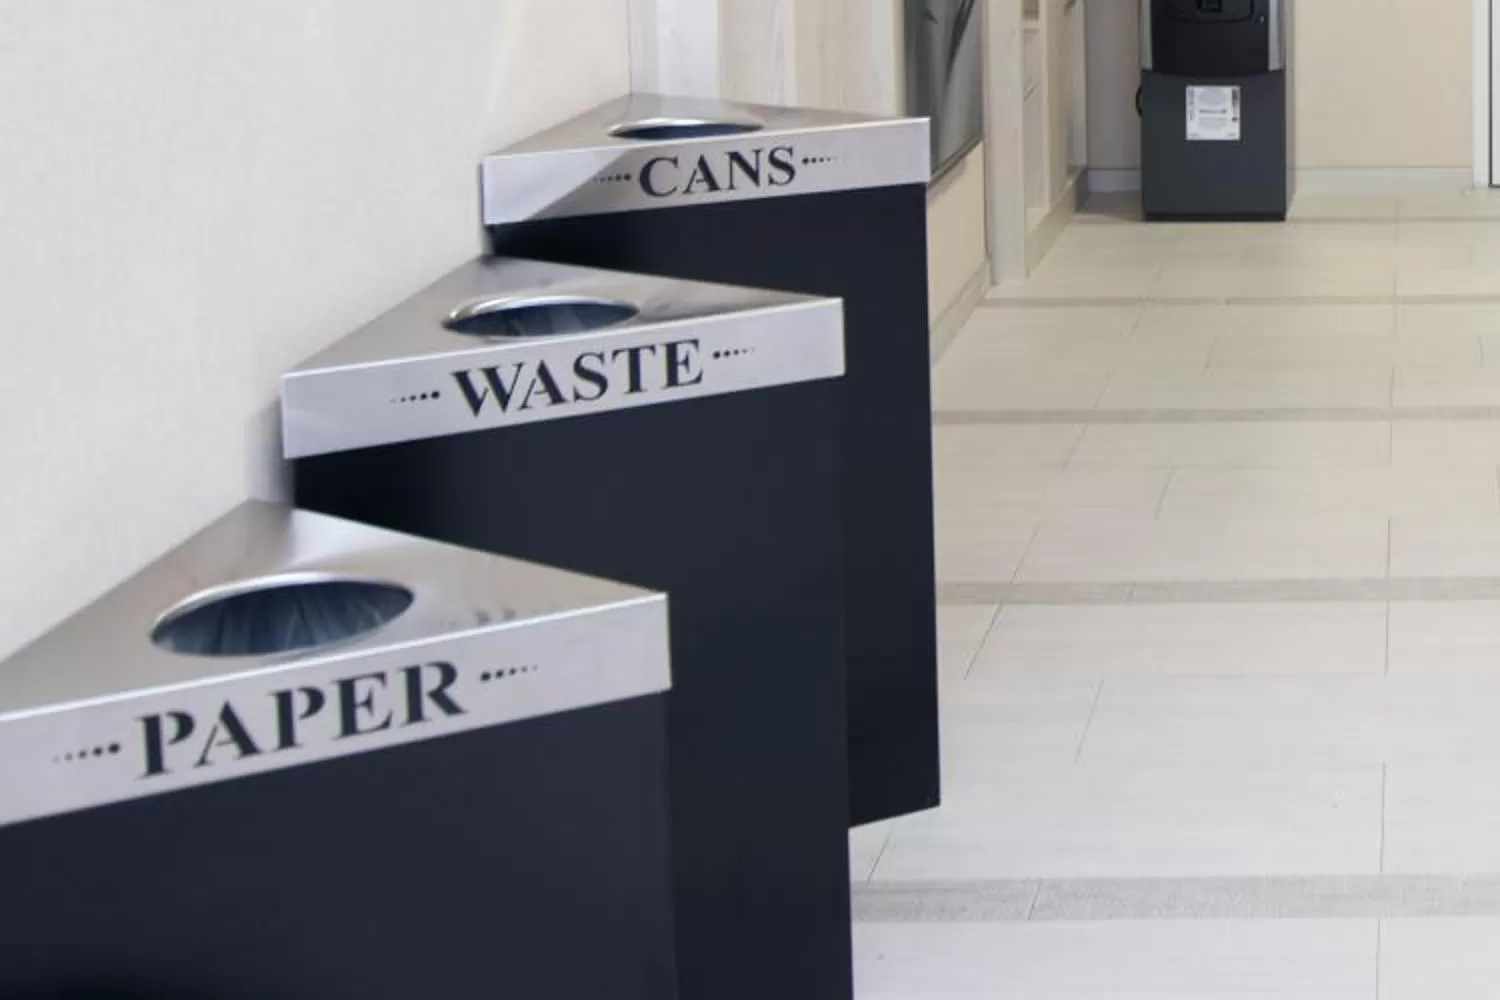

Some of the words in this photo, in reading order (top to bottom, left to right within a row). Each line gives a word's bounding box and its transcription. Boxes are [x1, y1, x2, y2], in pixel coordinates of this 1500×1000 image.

[638, 146, 797, 198] CANS
[450, 338, 704, 418] WASTE
[134, 660, 469, 779] PAPER
